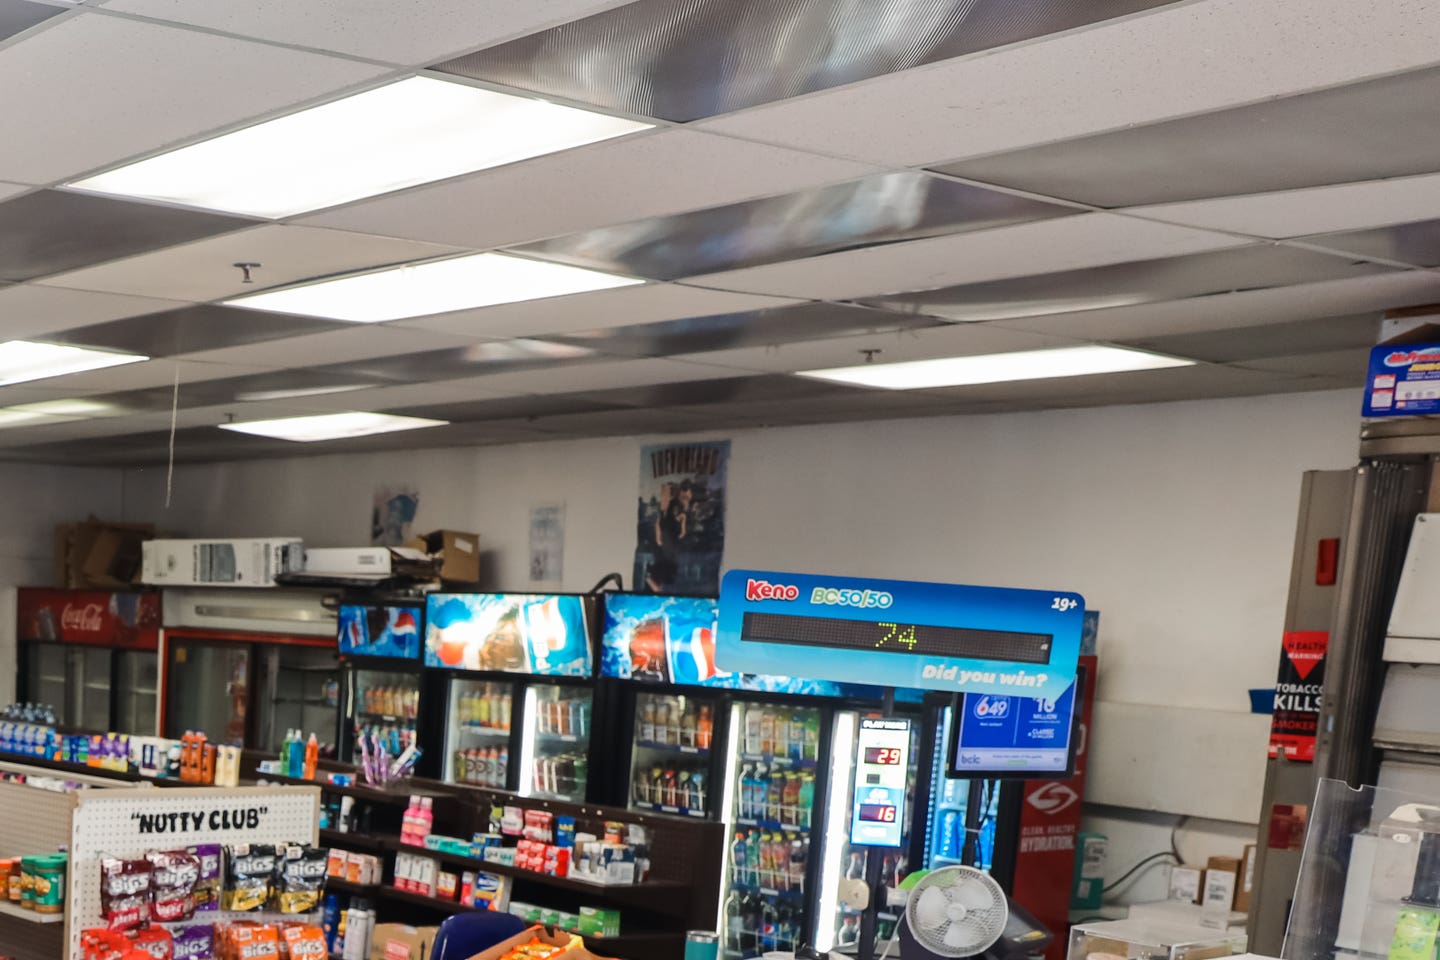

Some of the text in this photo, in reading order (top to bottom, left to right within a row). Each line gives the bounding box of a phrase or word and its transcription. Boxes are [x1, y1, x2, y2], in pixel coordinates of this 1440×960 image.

[746, 579, 1077, 611] Keno BC50/50 19+
[876, 622, 917, 650] 74
[922, 665, 1048, 688] Did you win?
[1274, 694, 1321, 712] KILLS
[877, 749, 900, 764] 29
[879, 807, 895, 822] 16
